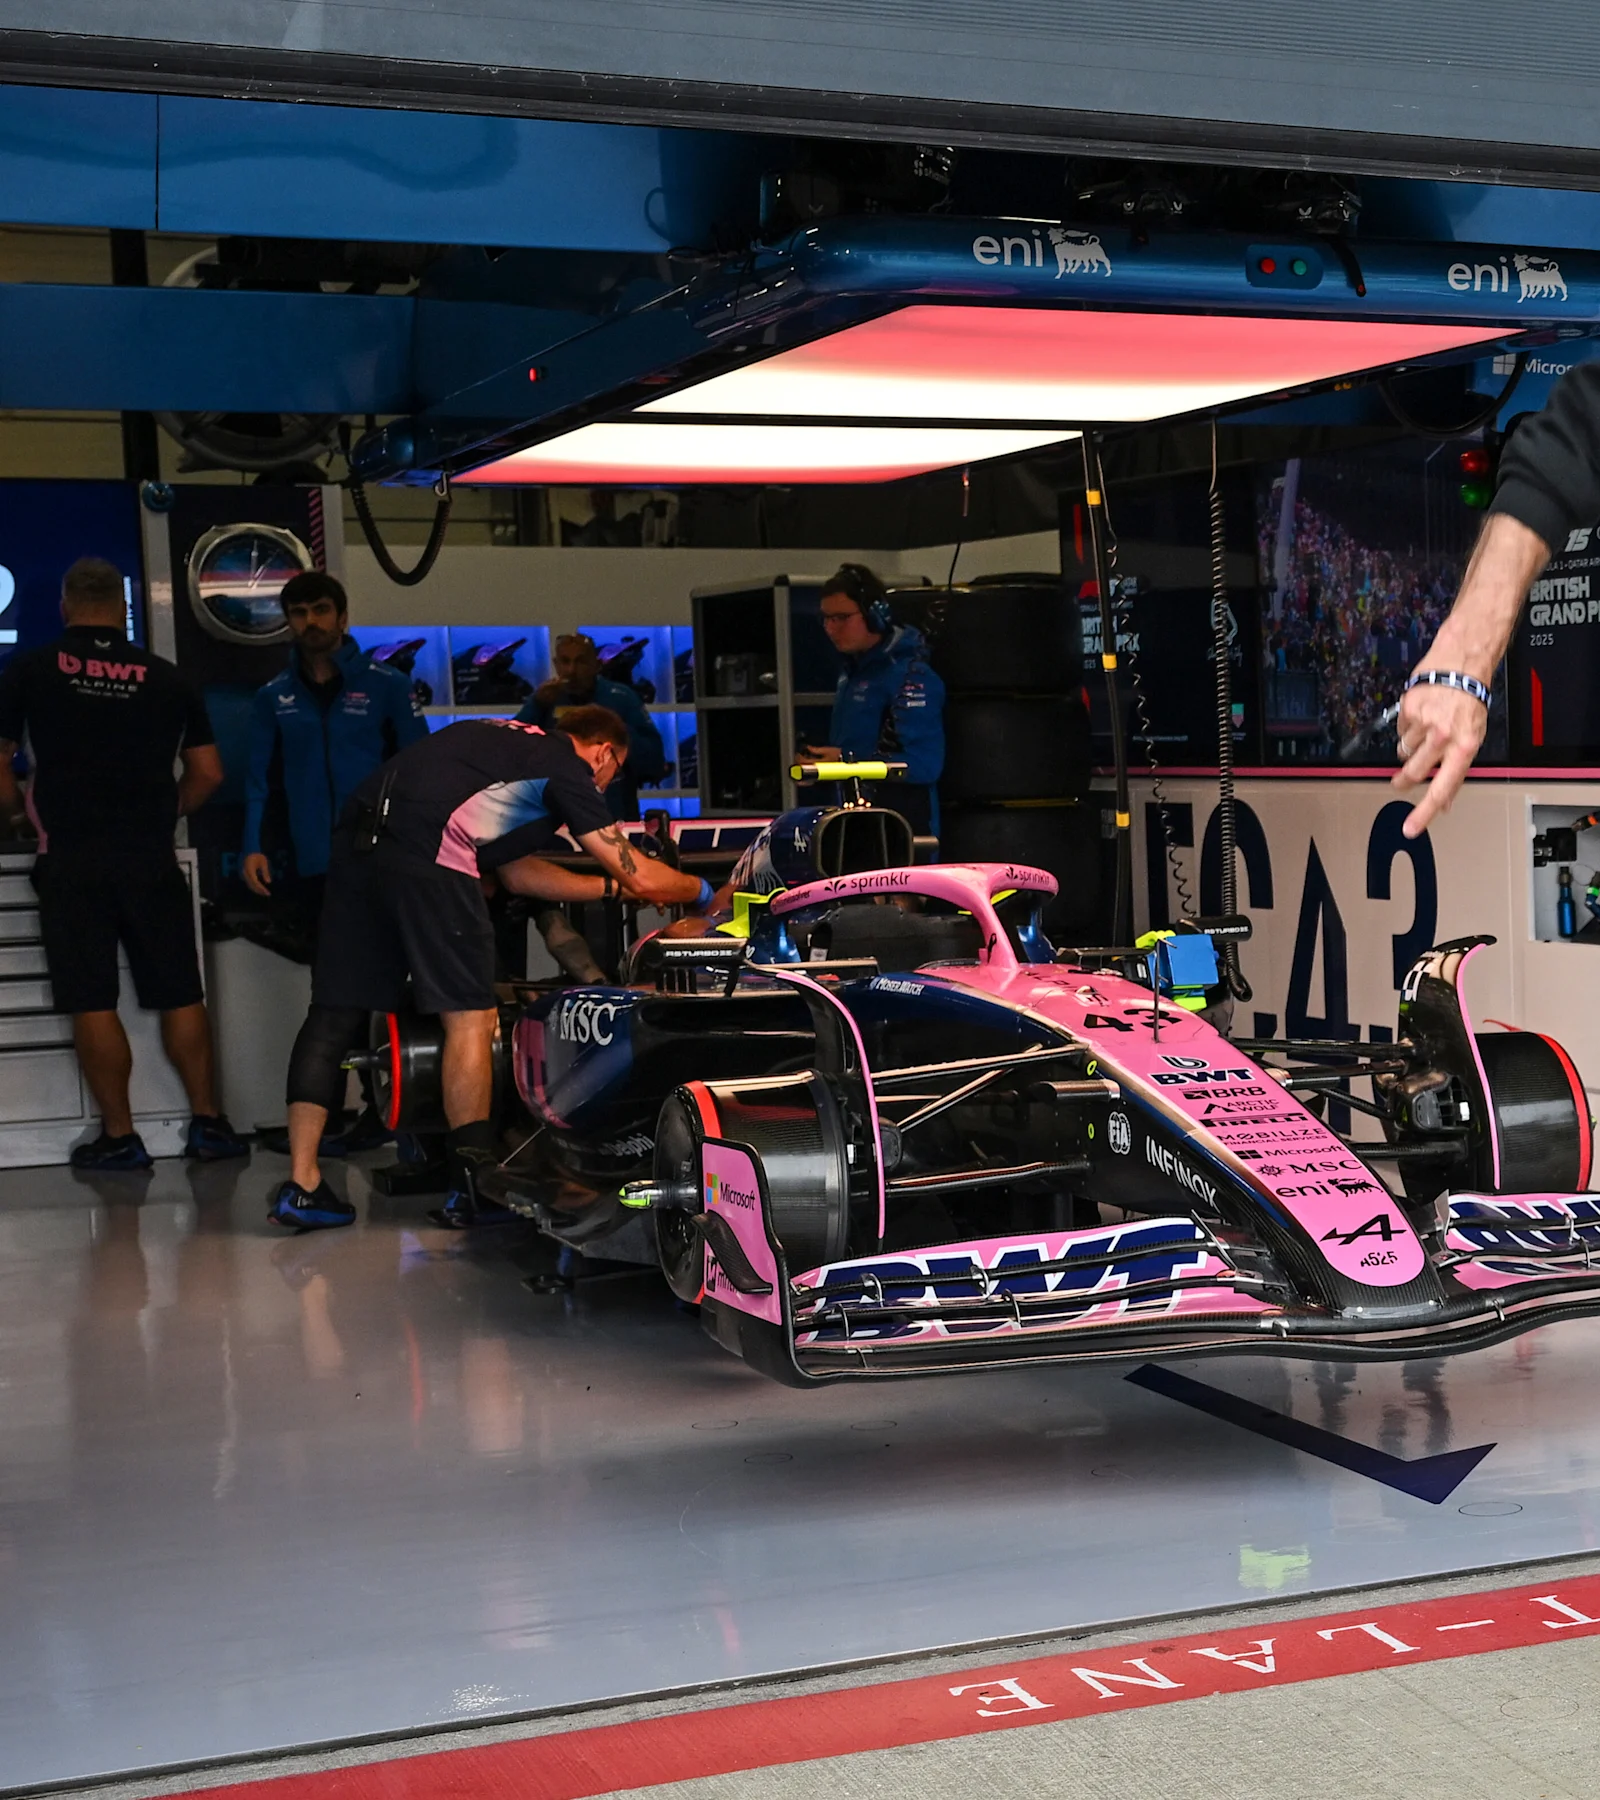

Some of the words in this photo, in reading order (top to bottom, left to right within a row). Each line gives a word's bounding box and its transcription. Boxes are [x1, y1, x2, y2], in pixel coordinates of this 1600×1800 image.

[973, 229, 1045, 268] eni
[1447, 255, 1509, 294] eni
[1564, 528, 1593, 553] 15
[1529, 575, 1591, 603] BRITISH
[1530, 601, 1586, 627] GRAND
[1529, 633, 1555, 646] 2025
[86, 659, 148, 683] BWT
[69, 678, 138, 693] ALPINE
[850, 870, 911, 893] sprinklr
[559, 998, 616, 1046] MSC
[1083, 1008, 1182, 1032] 43
[1148, 1066, 1257, 1086] BWT
[1211, 1086, 1267, 1099] BRB
[1226, 1098, 1280, 1108] ARCTIC
[1236, 1104, 1279, 1112] WOLF
[1280, 1134, 1329, 1143] SERVICES
[1264, 1145, 1346, 1158] Microsoft
[1145, 1134, 1218, 1208] INFINOX
[1288, 1159, 1364, 1174] MSC
[720, 1182, 756, 1212] Microsoft
[1275, 1180, 1331, 1198] eni
